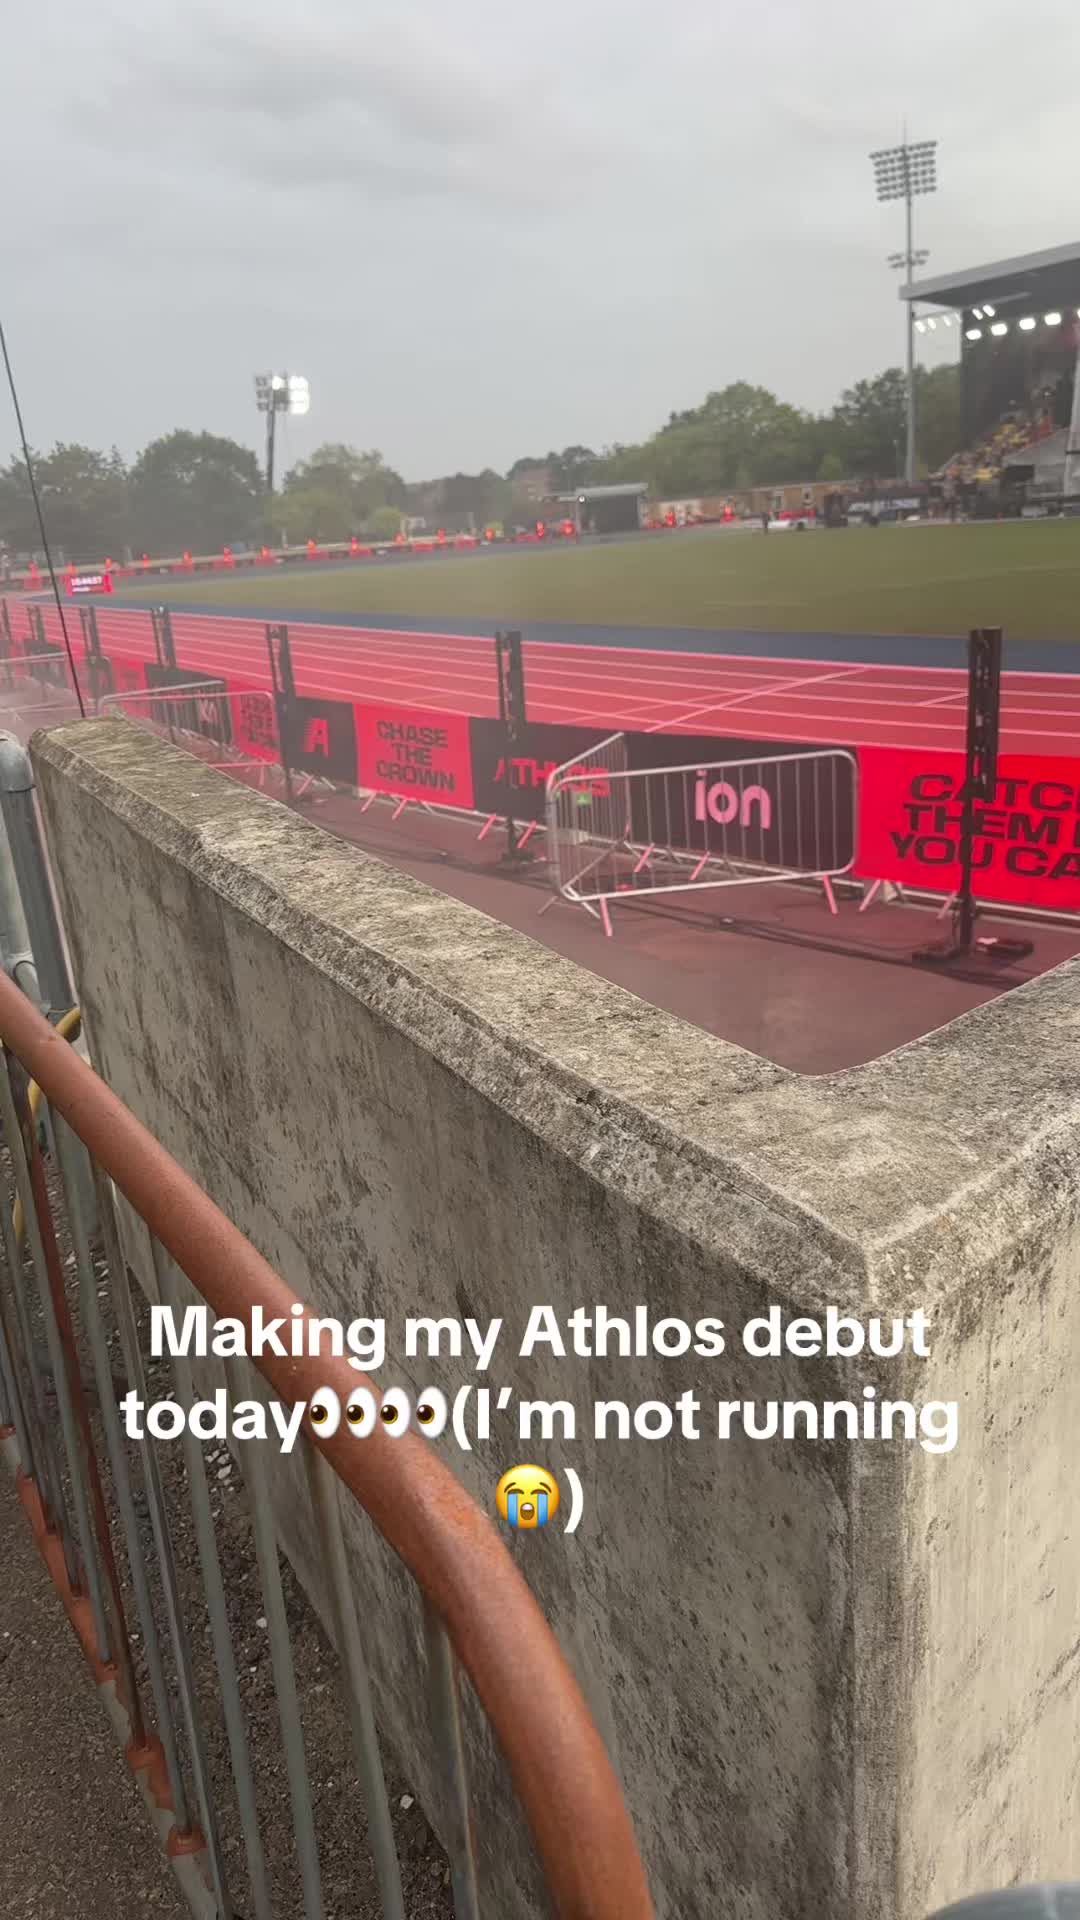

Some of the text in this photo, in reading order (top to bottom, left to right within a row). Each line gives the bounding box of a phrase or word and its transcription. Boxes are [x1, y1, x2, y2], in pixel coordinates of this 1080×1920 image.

[376, 720, 449, 750] CHASE
[391, 741, 433, 766] THE
[376, 759, 457, 791] CROWN
[695, 769, 771, 830] ion
[903, 803, 1061, 846] THEM
[890, 831, 994, 870] YOU
